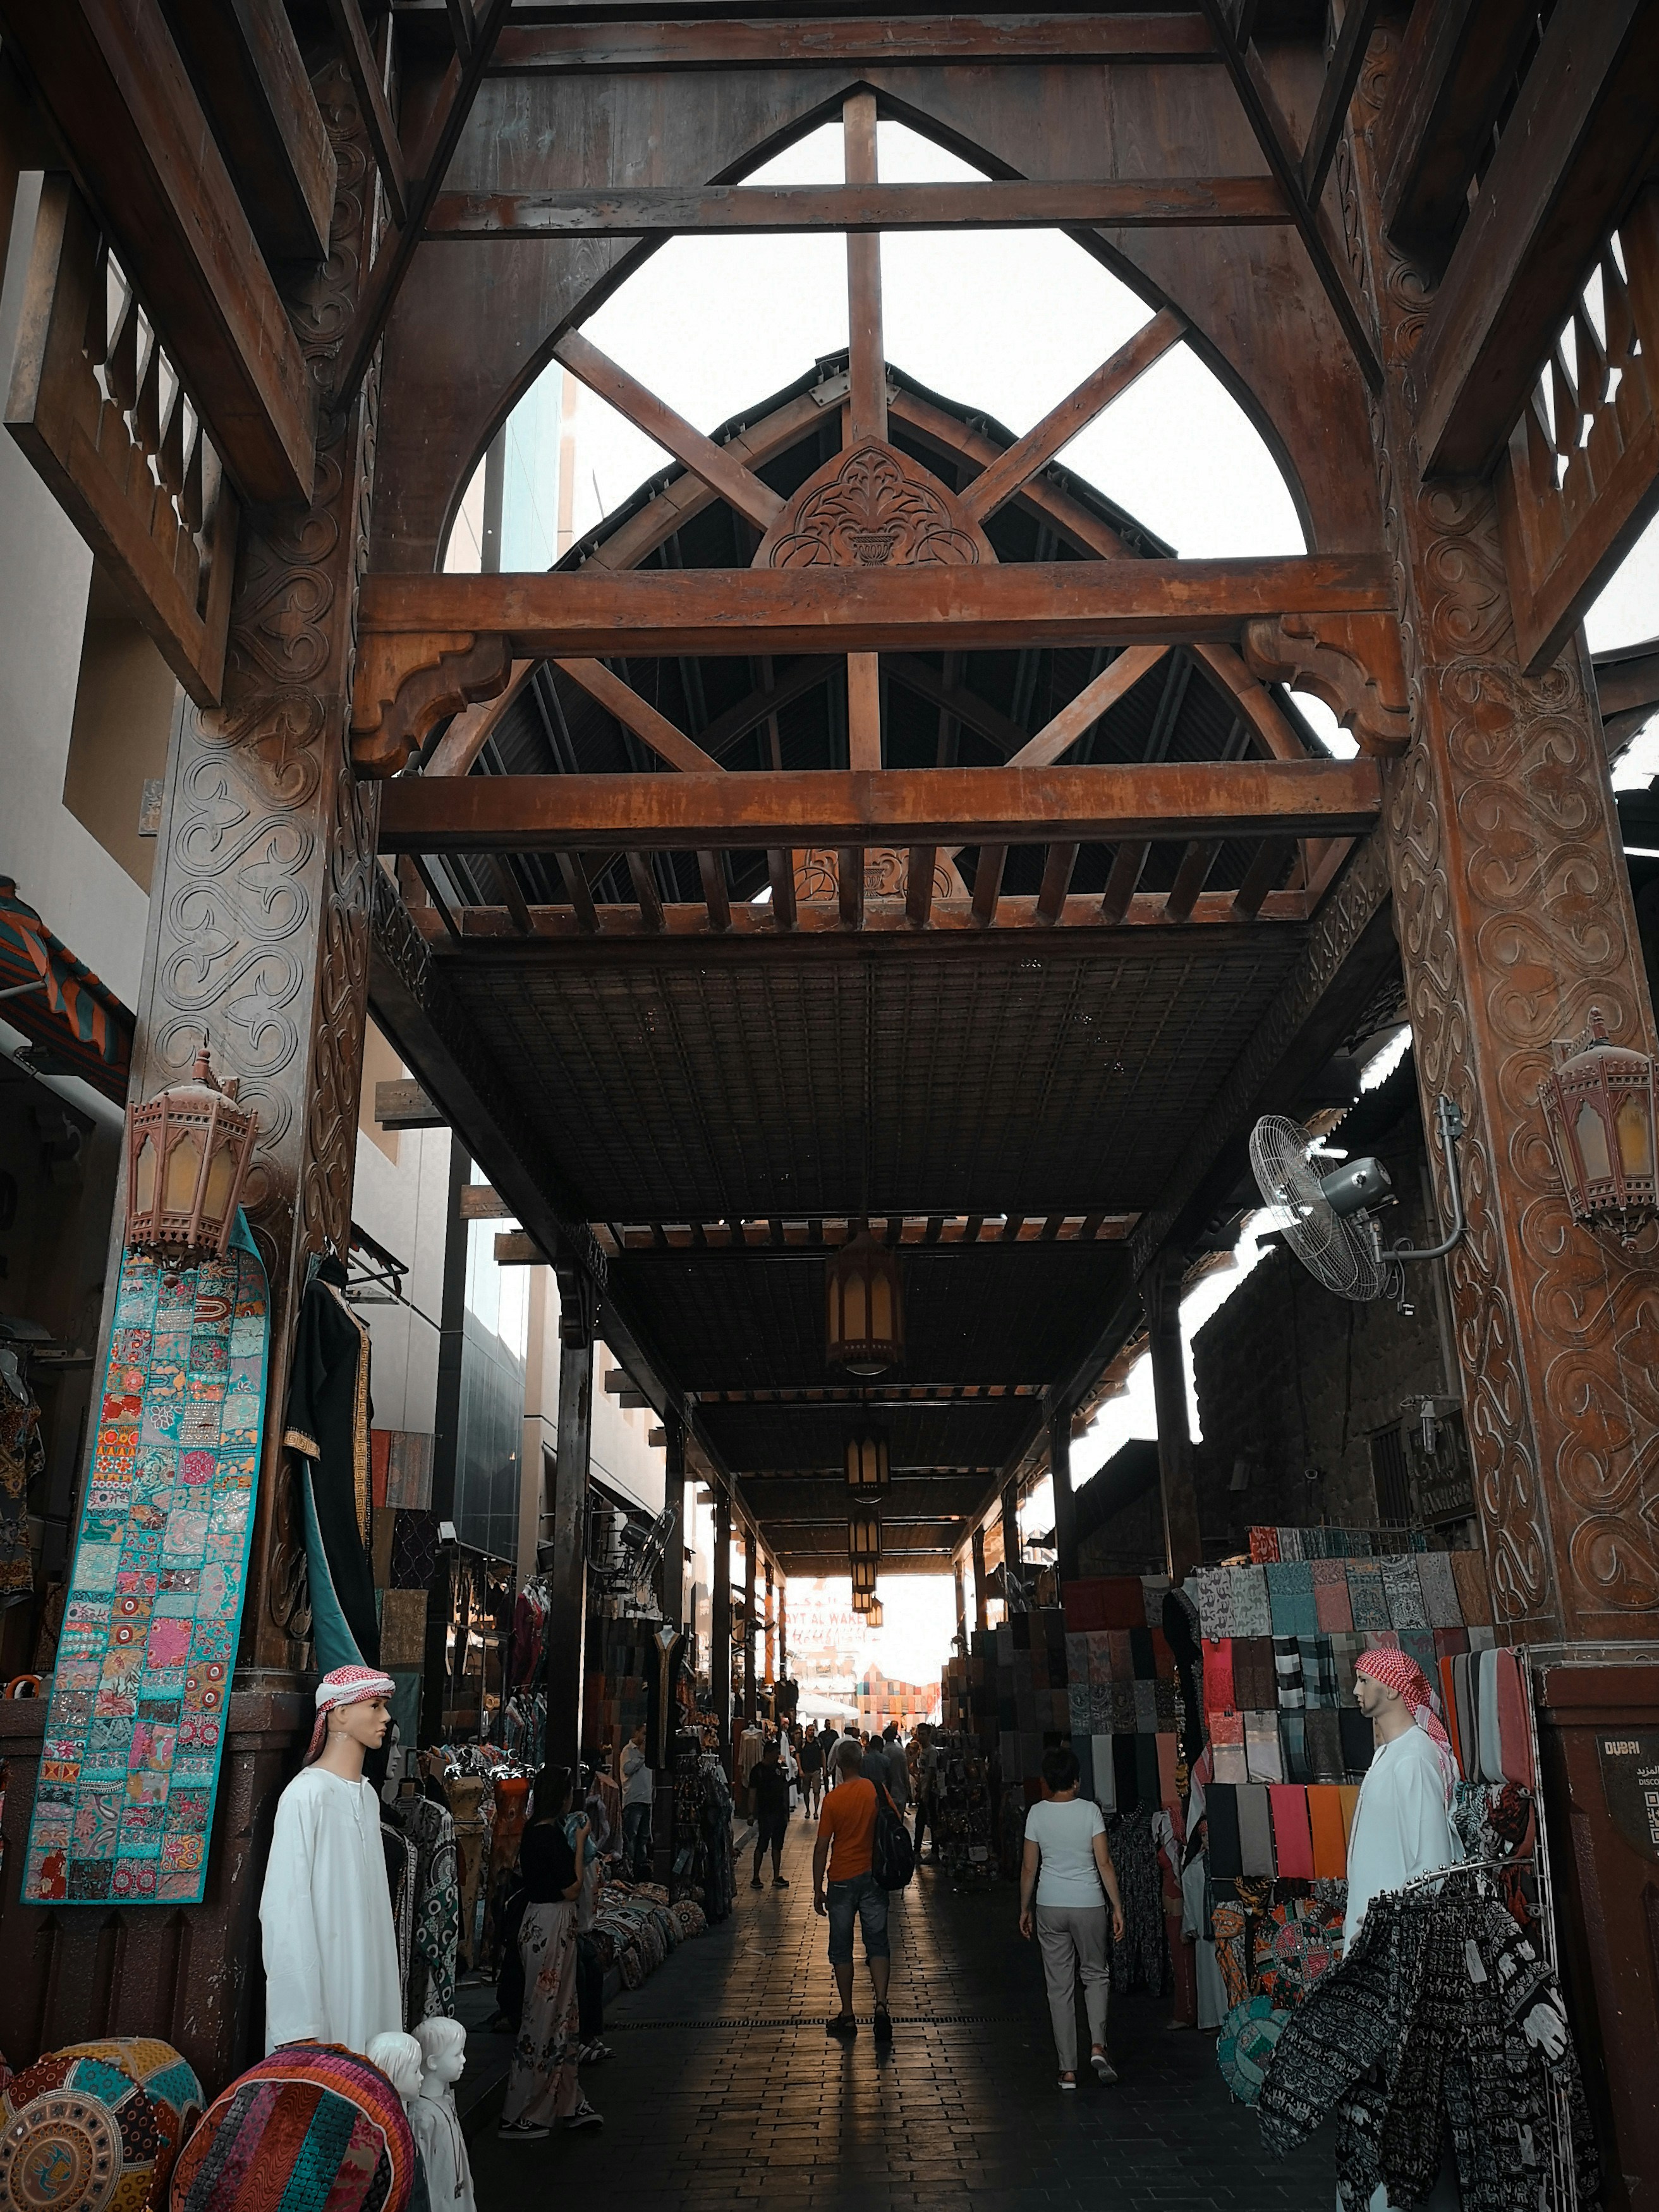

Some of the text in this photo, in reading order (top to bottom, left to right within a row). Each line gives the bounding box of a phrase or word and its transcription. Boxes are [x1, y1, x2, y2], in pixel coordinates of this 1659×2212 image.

[778, 1613, 866, 1625] AYT AL WAKE
[1604, 1741, 1641, 1756] DUBAI
